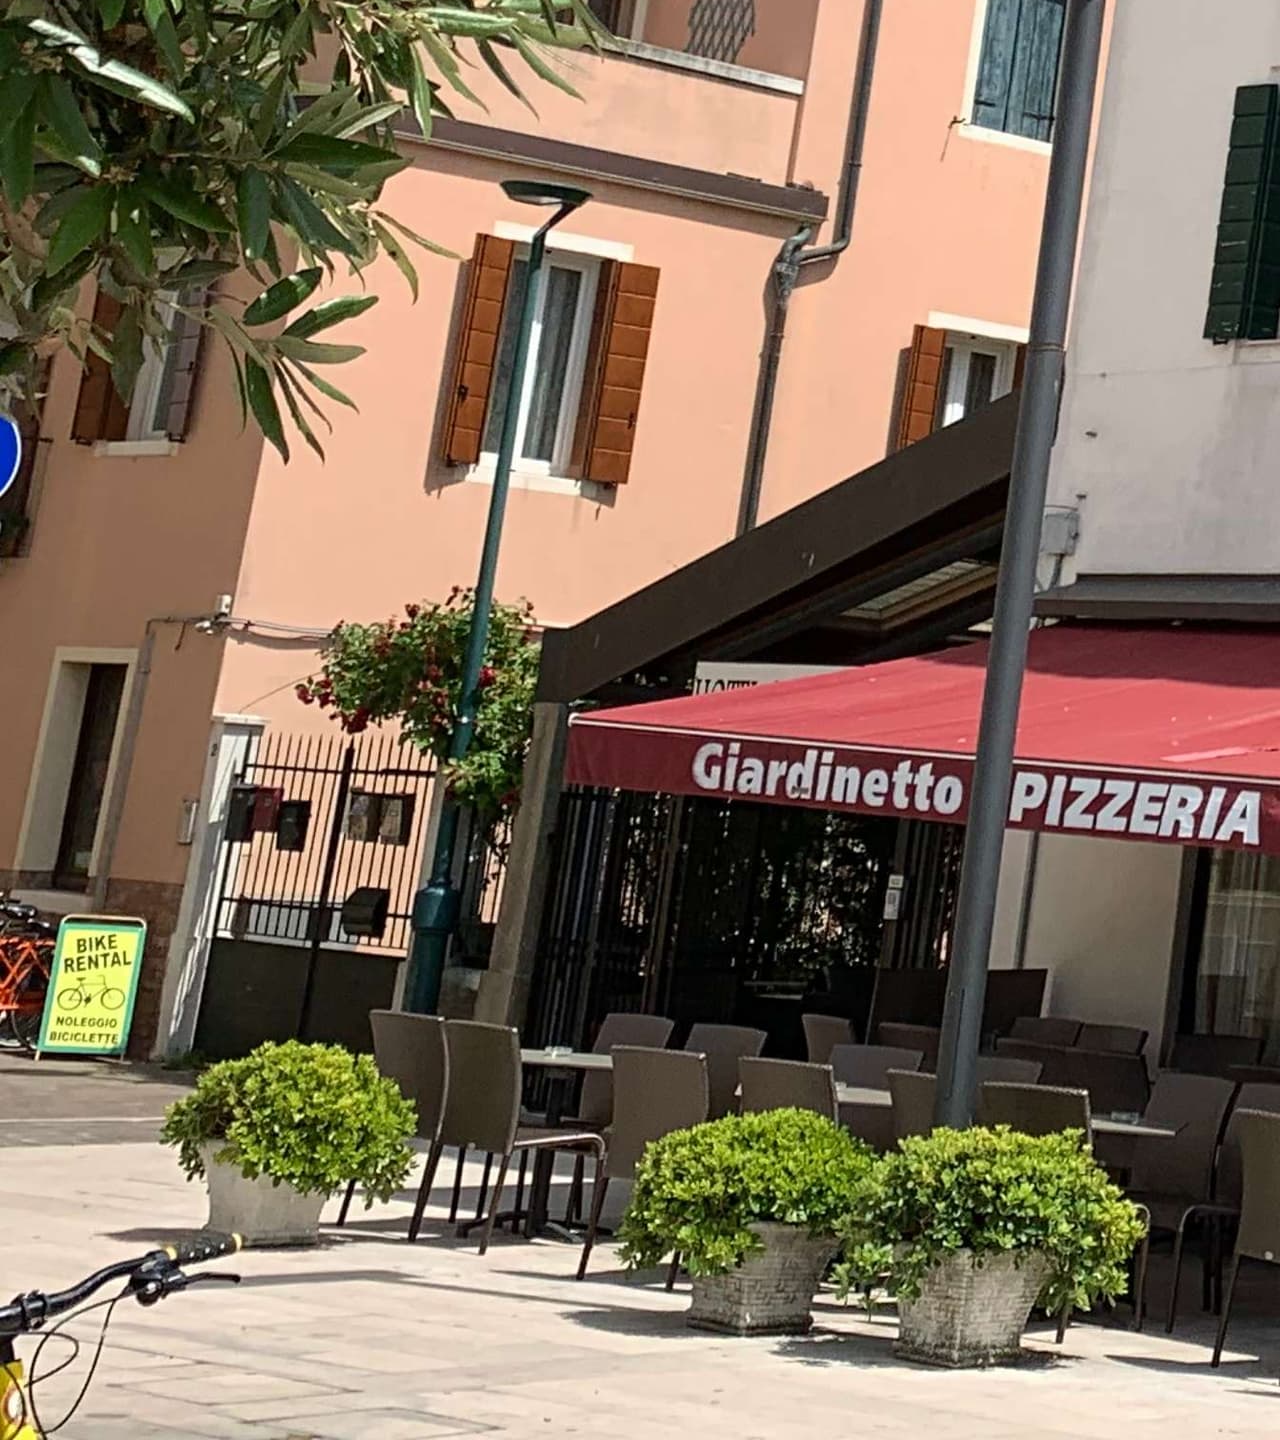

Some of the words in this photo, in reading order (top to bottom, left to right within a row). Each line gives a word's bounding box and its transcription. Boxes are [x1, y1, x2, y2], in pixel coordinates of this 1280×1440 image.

[691, 742, 963, 815] Giardinetto
[1008, 772, 1262, 846] PIZZERIA
[76, 934, 118, 954] BIKE
[63, 950, 132, 973] RENTAL
[56, 1016, 118, 1028] NOLEGGIO
[49, 1031, 119, 1044] BICICLETTE
